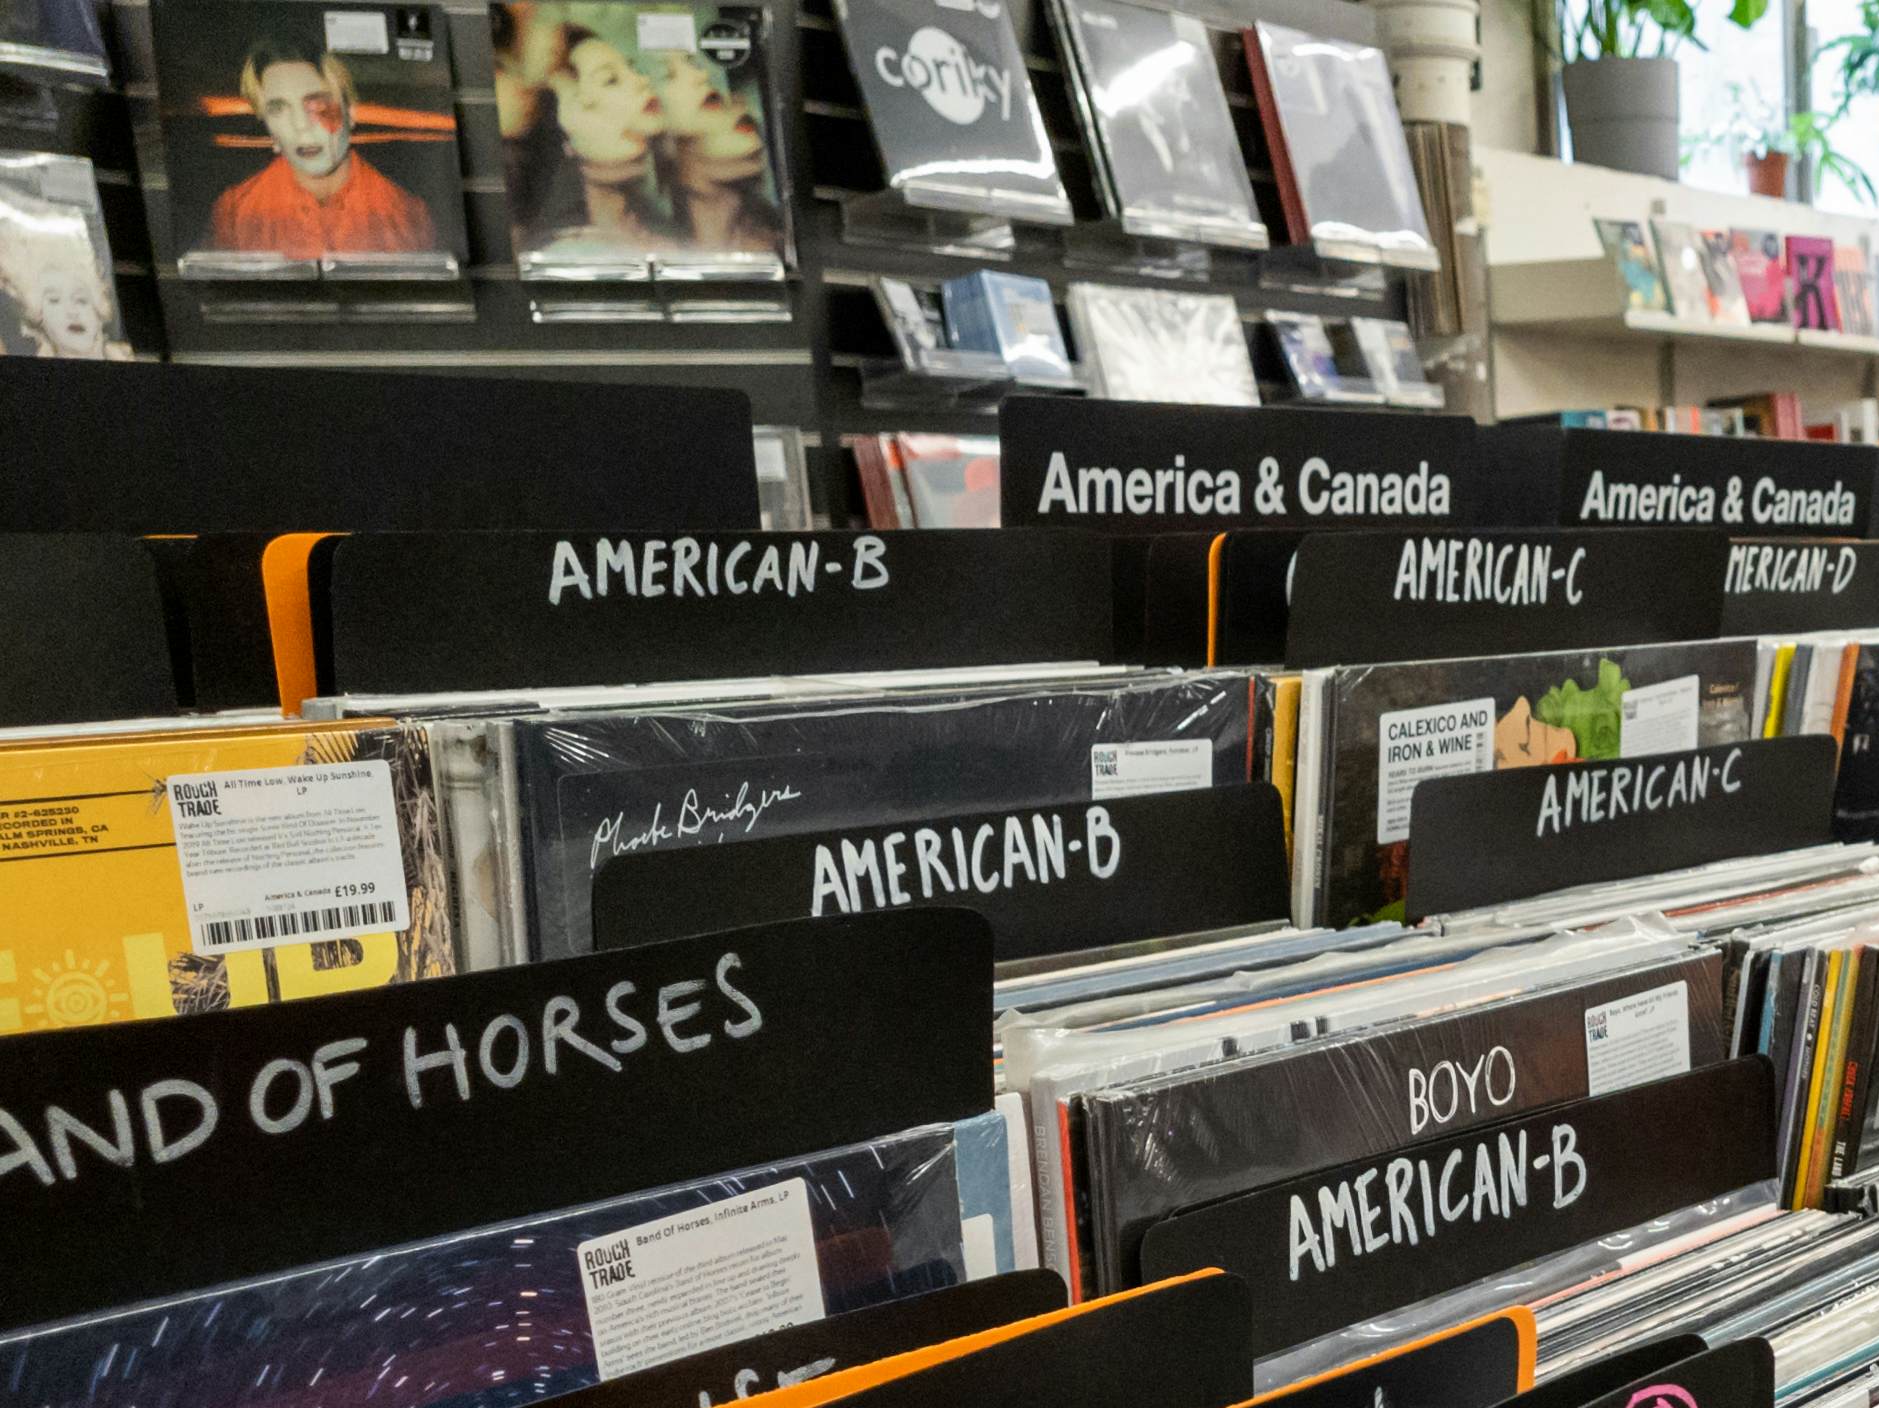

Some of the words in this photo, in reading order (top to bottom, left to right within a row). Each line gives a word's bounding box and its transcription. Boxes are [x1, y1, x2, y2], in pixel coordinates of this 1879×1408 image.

[874, 38, 1012, 120] coriky
[1037, 452, 1242, 517] America
[1257, 457, 1287, 515] &
[1300, 459, 1452, 517] Canada
[1580, 471, 1713, 523] America
[1722, 475, 1744, 524] &
[1752, 478, 1856, 526] Canada
[549, 534, 890, 604] AMERICAN-B
[1394, 538, 1587, 605] AMERICAN-C
[1388, 714, 1457, 742] CALEXICO
[1459, 710, 1489, 729] AND
[1387, 740, 1424, 764] IRON
[1425, 740, 1435, 757] &
[1439, 735, 1473, 754] WINE
[173, 780, 218, 801] ROUGH
[224, 780, 239, 790] All
[239, 779, 262, 789] Time
[287, 775, 314, 786] Wake
[315, 774, 329, 785] Up
[1536, 747, 1743, 838] AMERICAN-C
[60, 817, 74, 826] IN
[178, 799, 223, 819] TRADE
[81, 835, 99, 844] TN
[90, 824, 109, 834] CA
[810, 806, 1121, 918] AMERICAN-B
[334, 881, 377, 899] £19.99
[0, 1080, 219, 1186] AND
[250, 1038, 368, 1136] OF
[404, 952, 764, 1108] HORSES
[1409, 1044, 1517, 1136] BOYO
[1289, 1124, 1589, 1281] AMERICAN-B
[636, 1230, 662, 1247] Band
[663, 1225, 675, 1238] Of
[583, 1238, 631, 1271] ROUGH
[589, 1260, 636, 1290] TRADE
